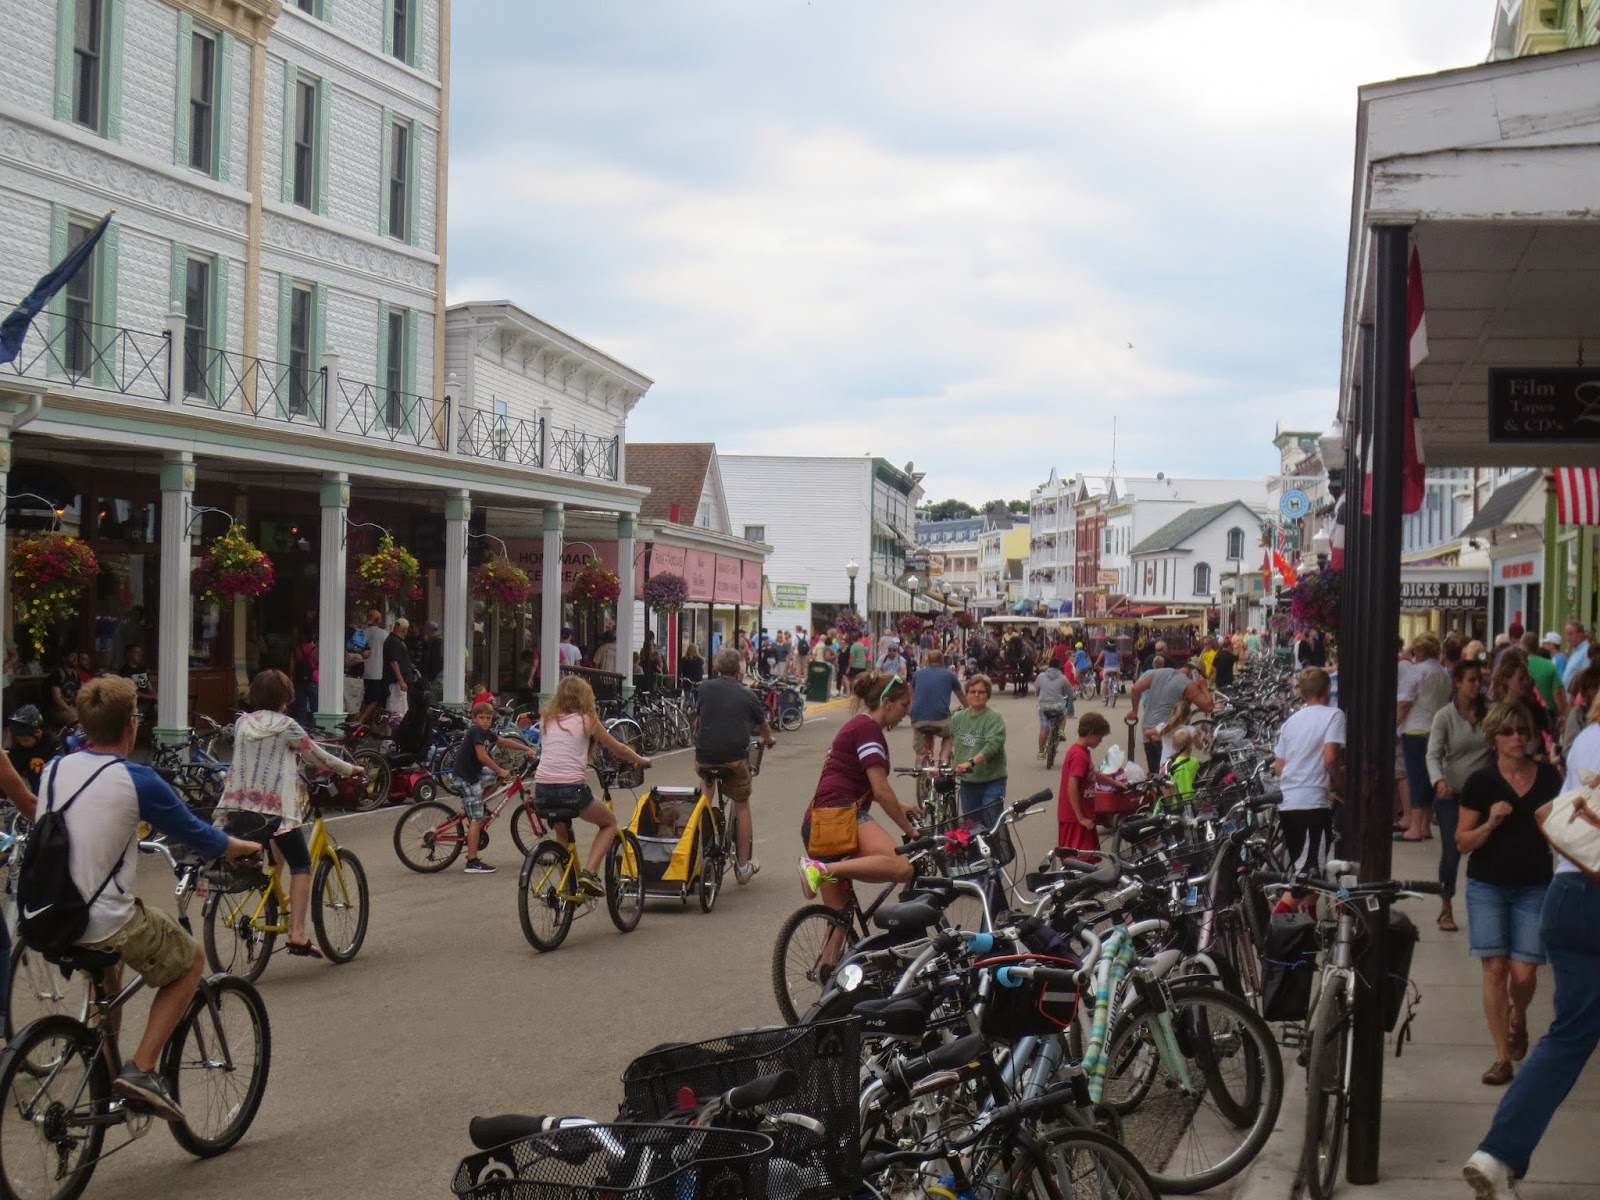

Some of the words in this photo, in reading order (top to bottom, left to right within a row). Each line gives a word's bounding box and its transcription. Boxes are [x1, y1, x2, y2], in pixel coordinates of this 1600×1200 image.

[1510, 378, 1557, 396] Film
[1510, 399, 1555, 416] Tapes
[1503, 418, 1518, 431] &
[560, 553, 592, 565] MAD
[1402, 583, 1441, 597] DICKS
[1447, 583, 1488, 597] FUDGE
